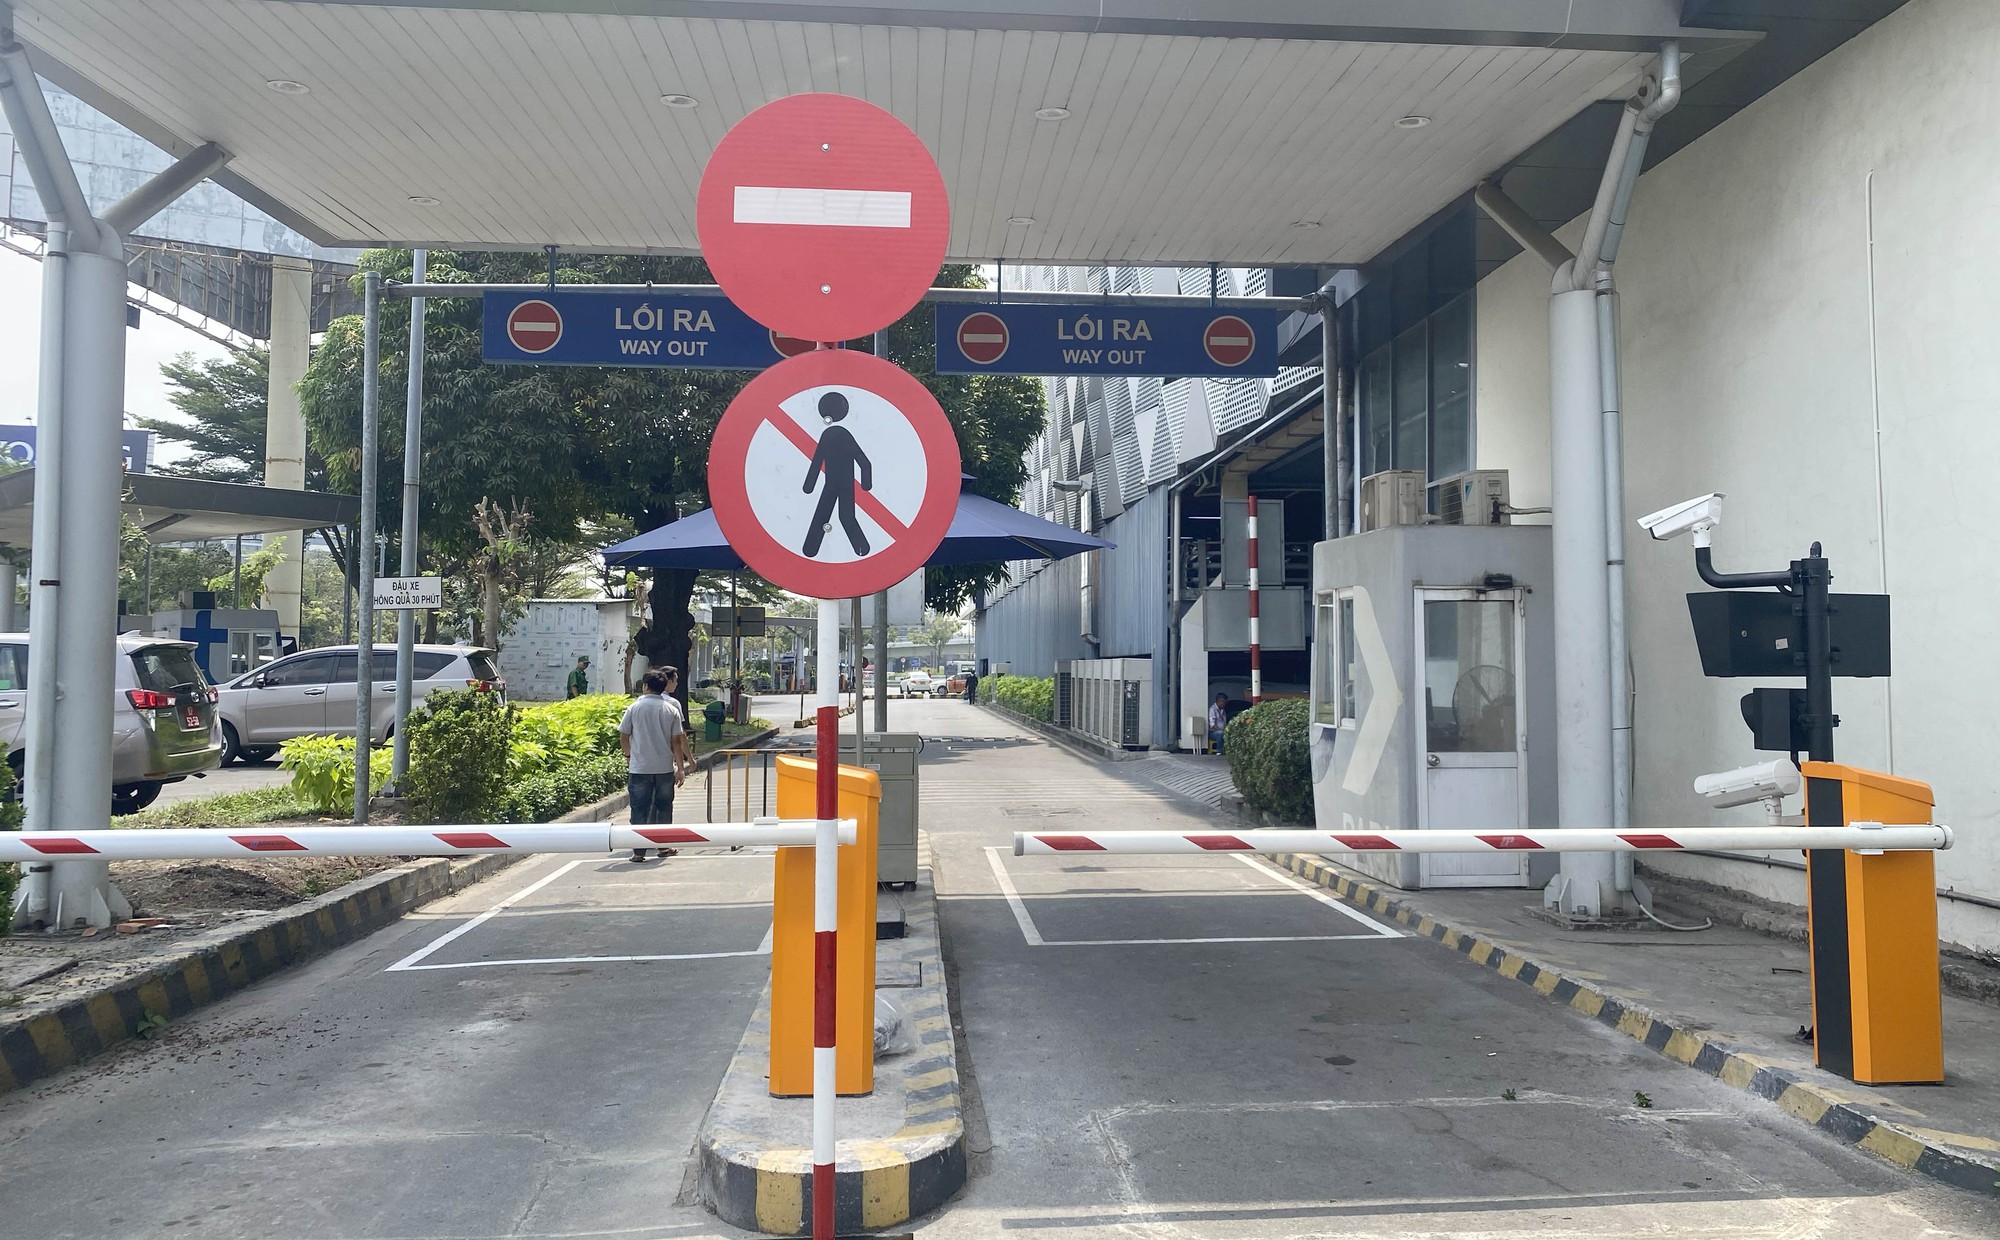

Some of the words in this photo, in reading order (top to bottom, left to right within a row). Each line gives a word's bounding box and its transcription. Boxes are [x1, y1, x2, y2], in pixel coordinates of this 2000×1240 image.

[615, 303, 663, 331] LỐI
[673, 308, 716, 332] RA
[1058, 313, 1103, 341] LỐI
[1113, 319, 1153, 341] RA
[619, 339, 663, 355] WAY
[667, 340, 709, 356] OUT
[1062, 349, 1103, 364] WAY
[1107, 350, 1146, 365] OUT
[410, 581, 419, 590] XE
[374, 595, 394, 605] HÔNG
[412, 595, 420, 604] 30
[421, 593, 440, 604] PHÚT
